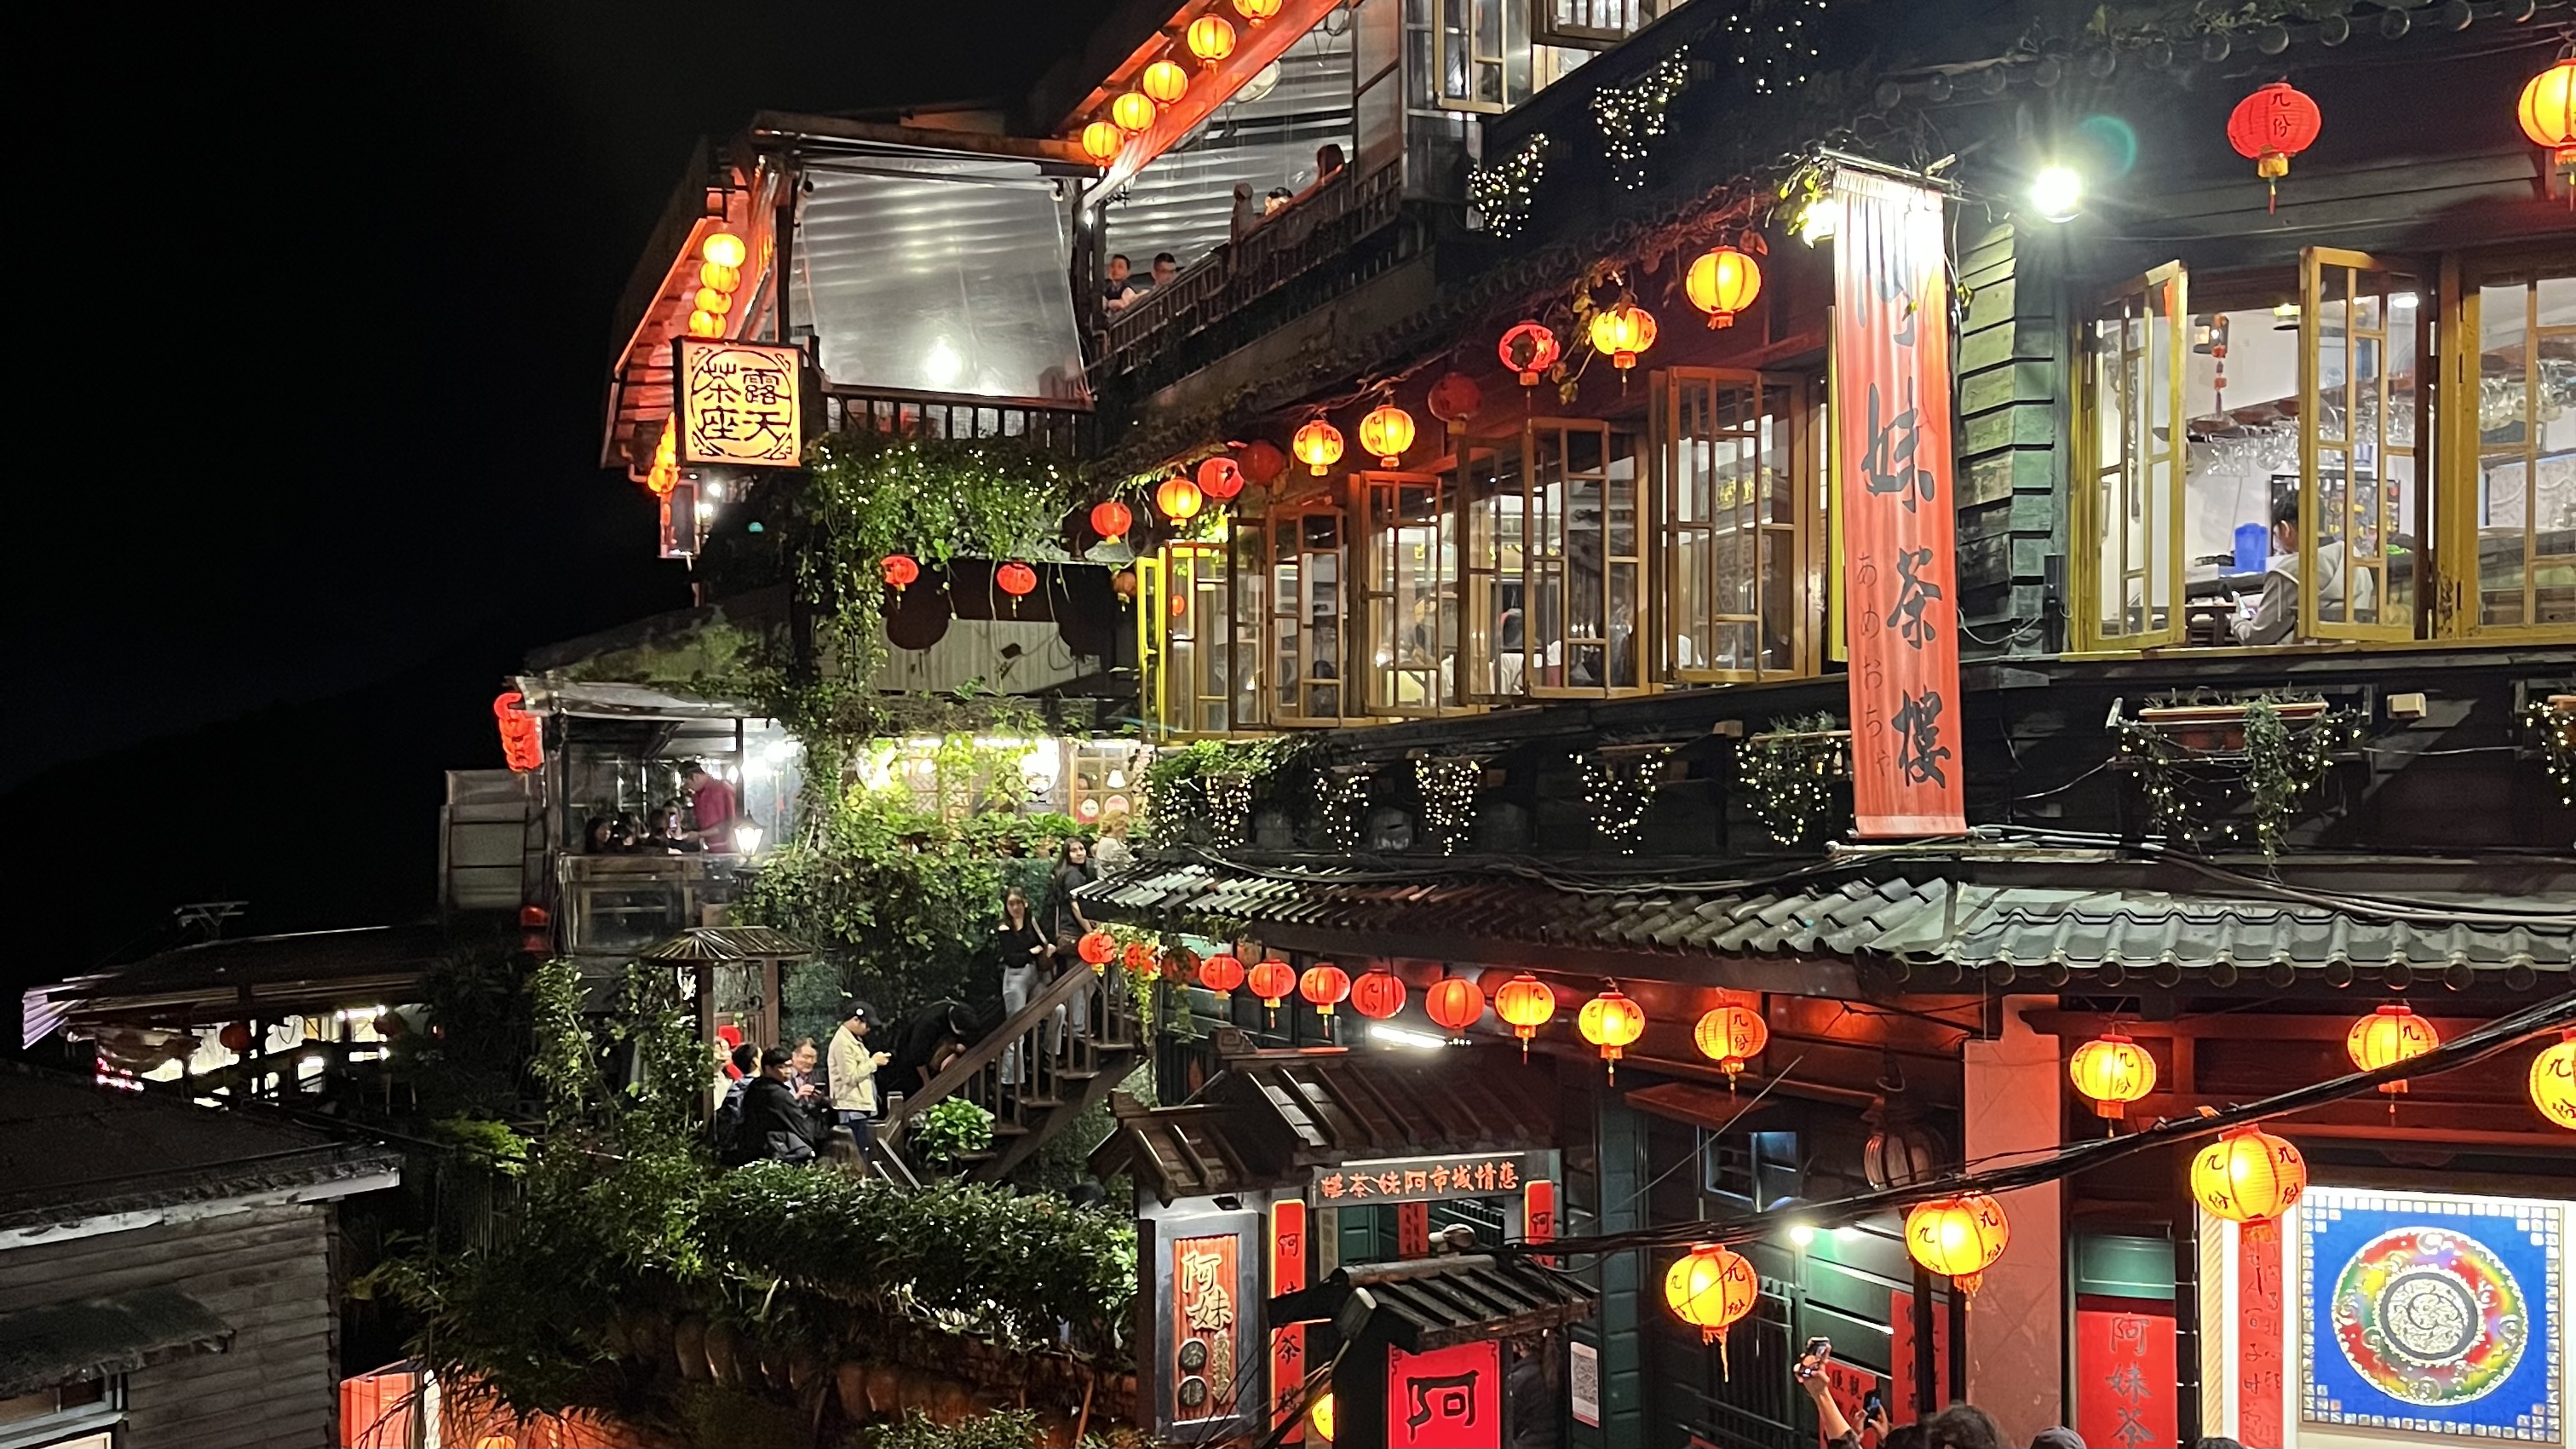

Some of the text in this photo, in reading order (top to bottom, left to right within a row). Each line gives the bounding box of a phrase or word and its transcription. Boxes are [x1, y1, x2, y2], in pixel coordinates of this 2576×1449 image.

[2272, 93, 2291, 137] 九份
[692, 362, 741, 441] 茶座
[739, 367, 791, 443] 露天
[1734, 1014, 1748, 1051] 九份
[2119, 1052, 2134, 1094] 九份
[2204, 1154, 2230, 1210] 九份
[2278, 1146, 2298, 1205] 九份
[1728, 1267, 1746, 1315] 九份
[1406, 1370, 1480, 1442] 阿
[2106, 1317, 2155, 1449] 阿妹茶
